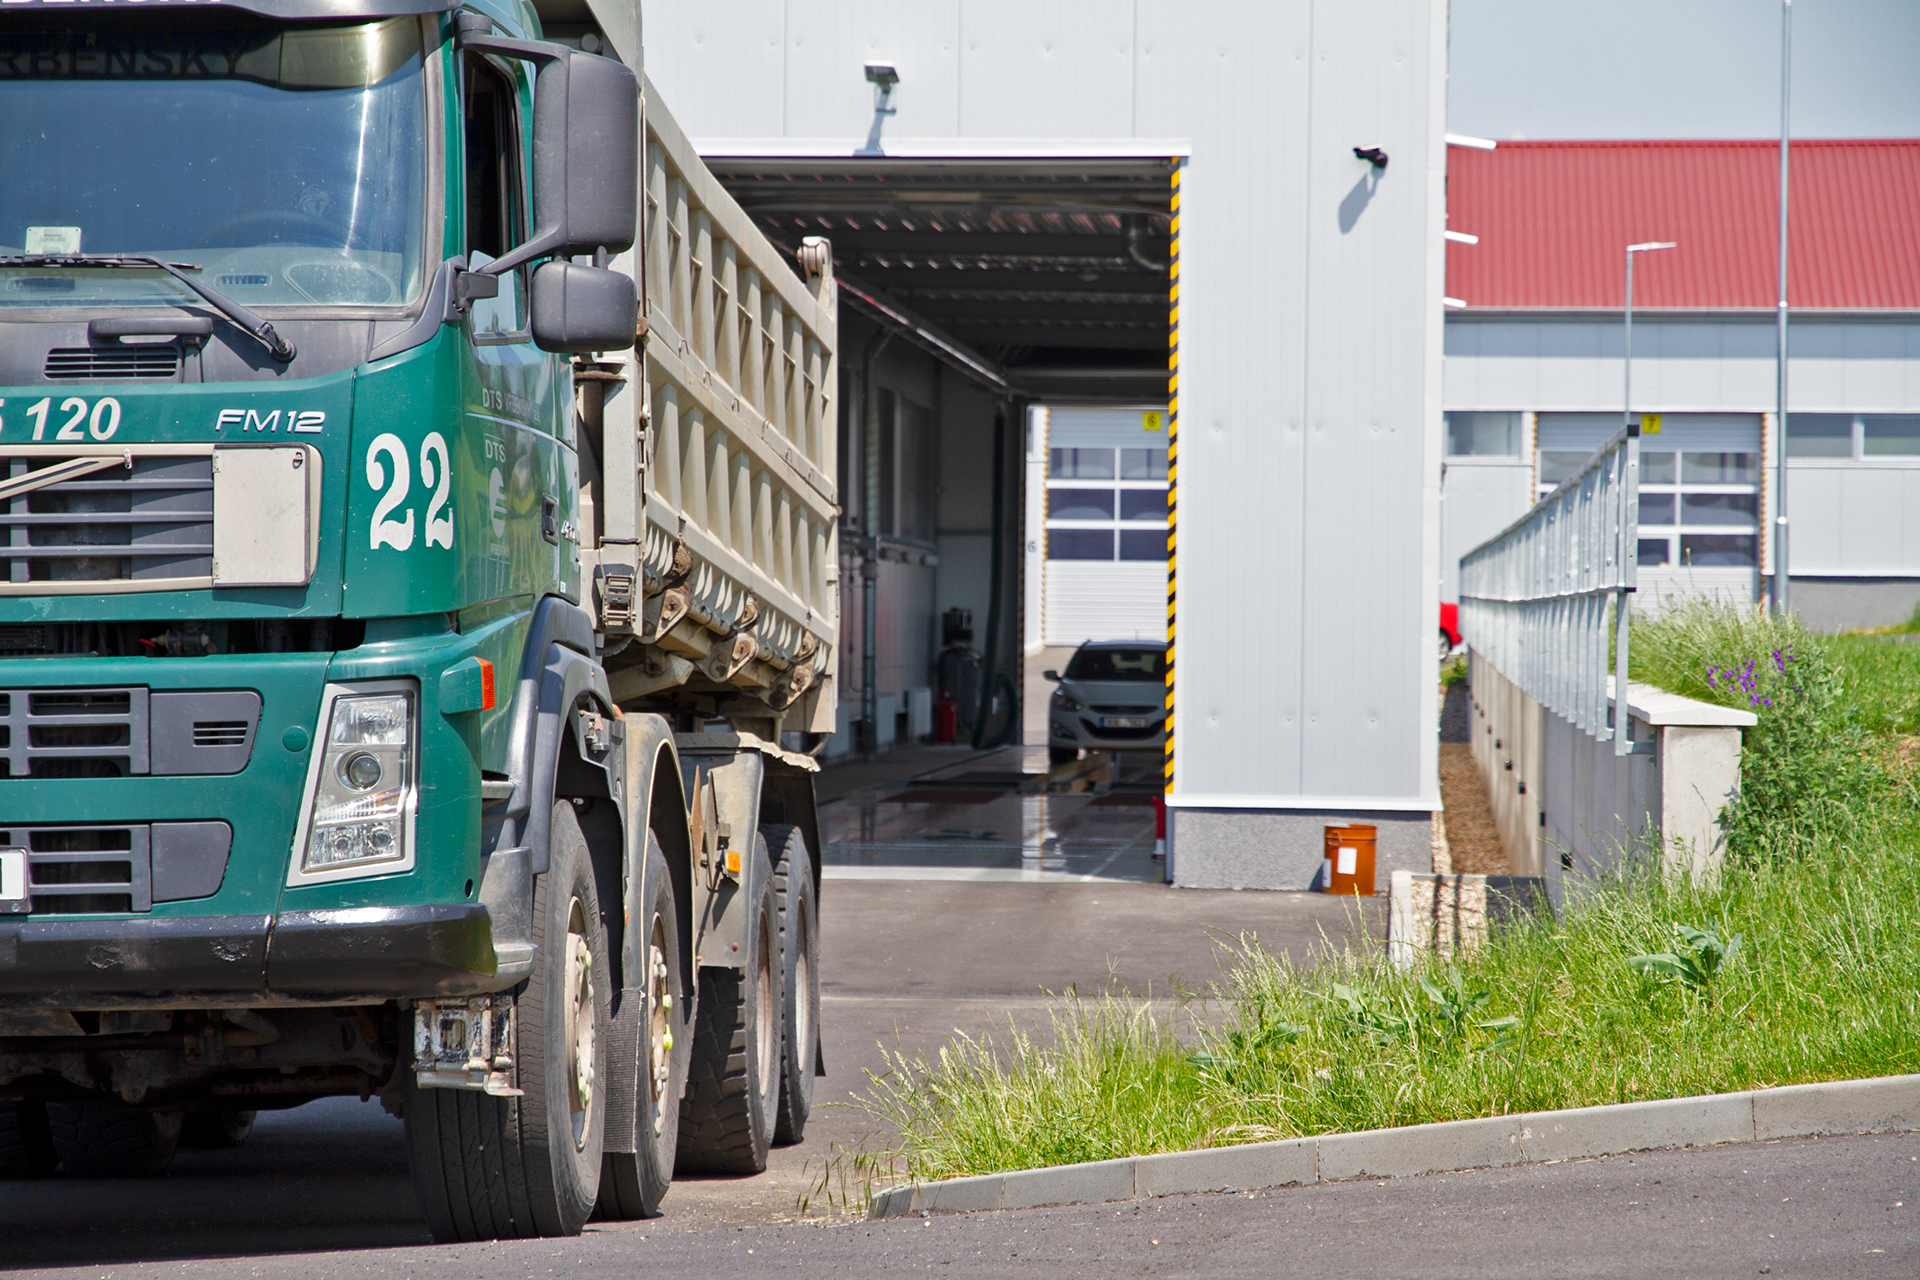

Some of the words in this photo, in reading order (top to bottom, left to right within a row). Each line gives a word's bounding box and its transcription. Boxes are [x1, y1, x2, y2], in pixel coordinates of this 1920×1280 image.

[482, 388, 503, 411] DTS
[26, 397, 121, 440] 120
[215, 409, 326, 433] FM12
[485, 440, 506, 464] DTS
[366, 431, 454, 551] 22
